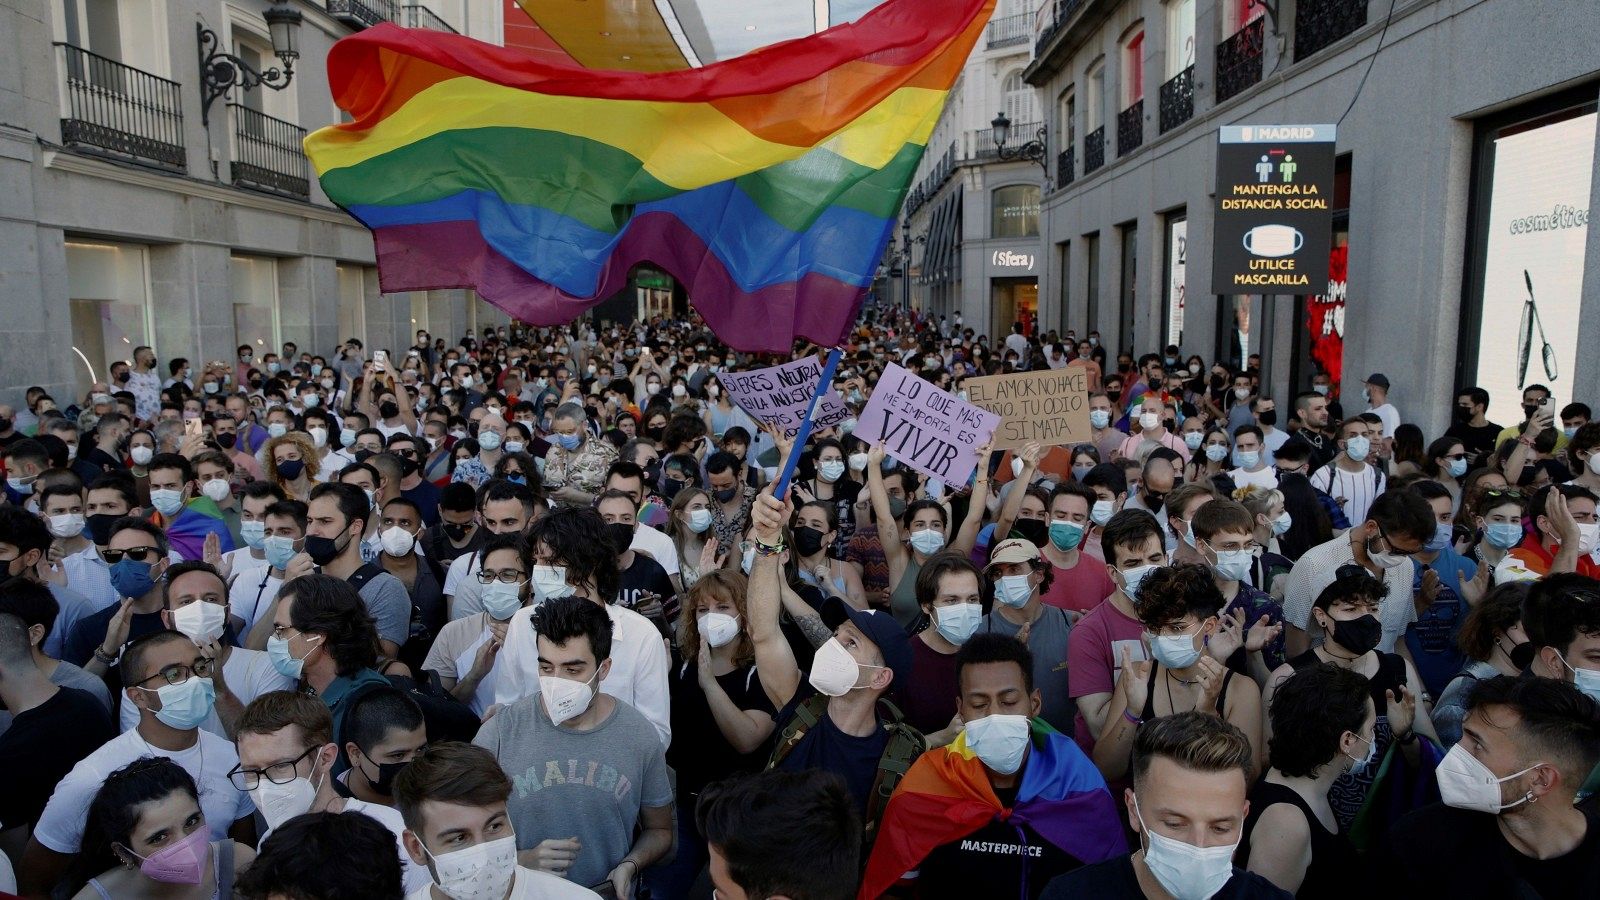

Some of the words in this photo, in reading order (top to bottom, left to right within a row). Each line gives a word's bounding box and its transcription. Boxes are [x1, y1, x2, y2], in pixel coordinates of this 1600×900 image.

[1259, 127, 1315, 139] MADRID
[1233, 184, 1300, 195] MANTENGA
[1303, 184, 1318, 195] LA
[1222, 199, 1283, 210] DISTANCIA
[1286, 198, 1328, 210] SOCIAL
[1249, 259, 1295, 270] UTILICE
[1234, 274, 1309, 285] MASCARILLA
[738, 373, 773, 395] ERES
[969, 385, 993, 402] EL
[996, 378, 1037, 399] AMOR
[1038, 377, 1057, 396] NO
[1057, 374, 1086, 393] HACE
[897, 375, 922, 400] LO
[926, 391, 955, 417] QUE
[1021, 399, 1040, 415] TU
[1043, 395, 1082, 415] ODIO
[820, 401, 839, 413] EL
[882, 392, 900, 407] ME
[900, 401, 951, 435] IMPORTA
[957, 430, 976, 445] ES
[1032, 417, 1072, 440] MATA
[878, 408, 958, 477] VIVIR
[513, 759, 632, 799] MALIBU
[960, 840, 1043, 857] MASTERPIECE
